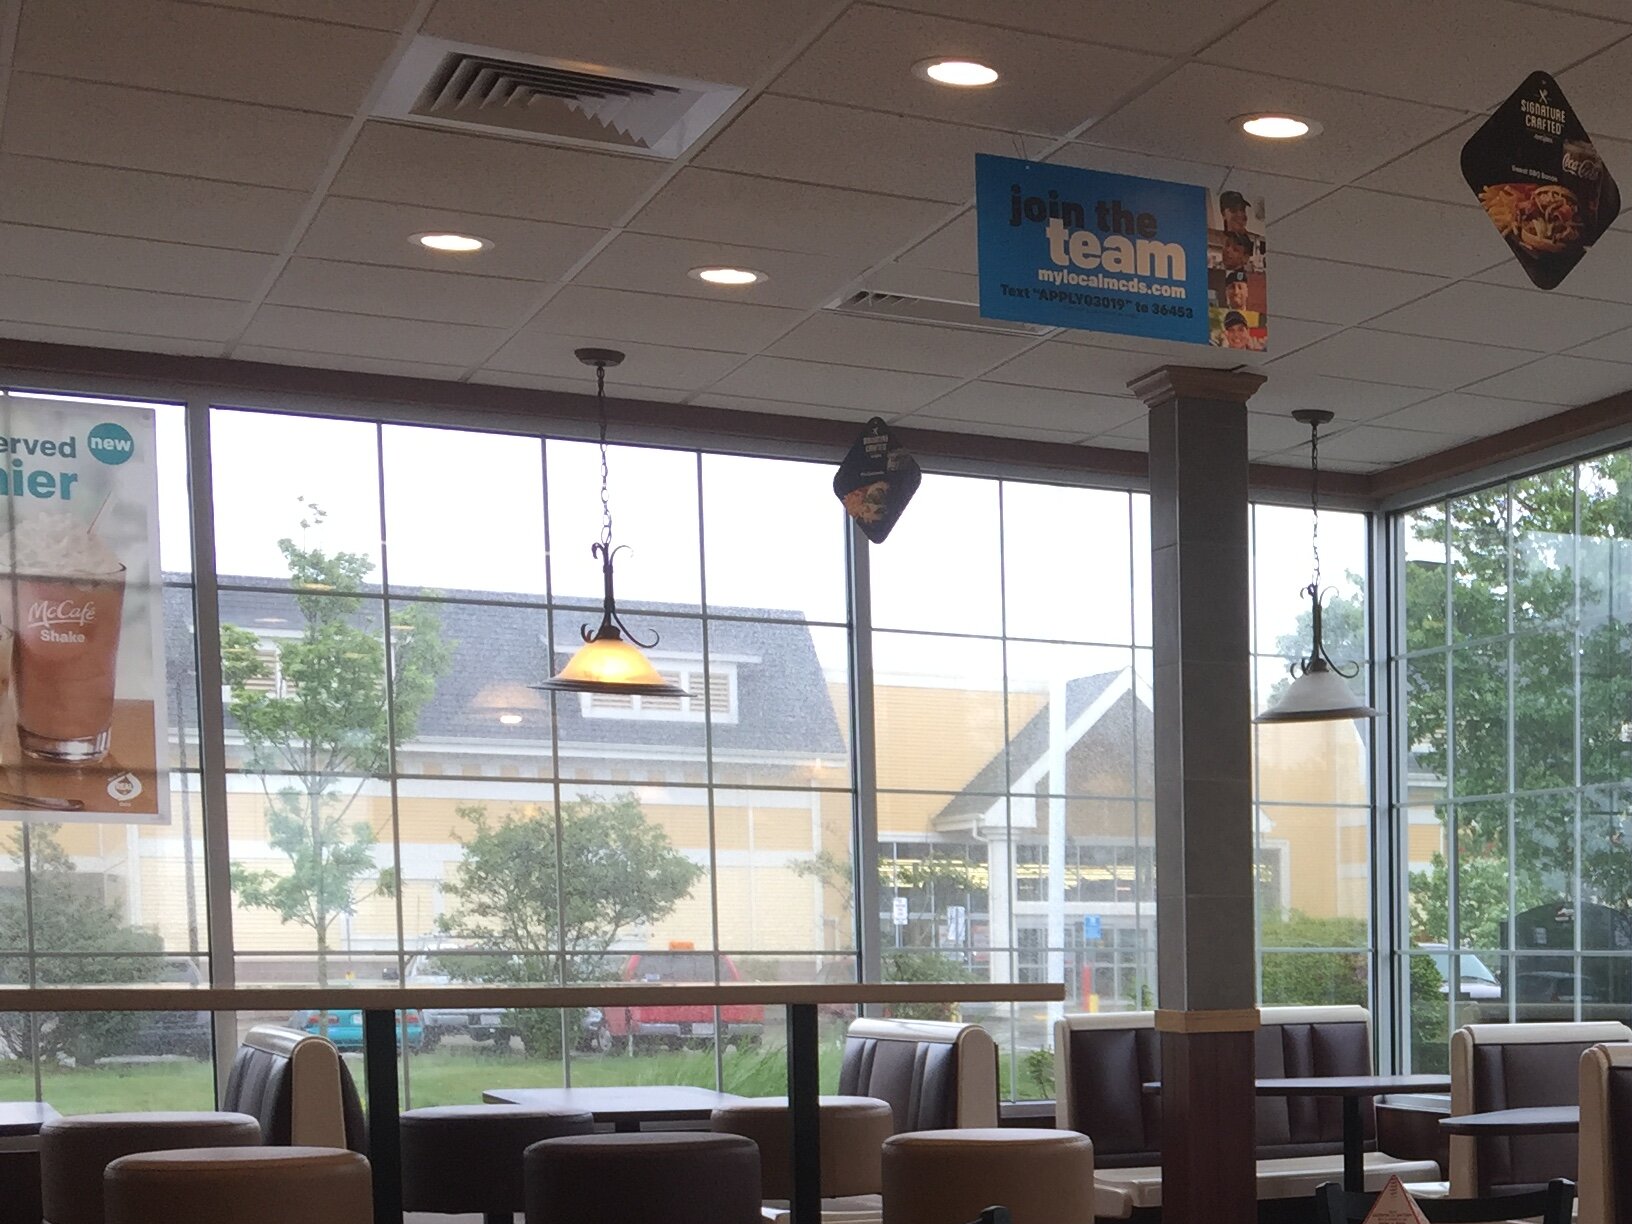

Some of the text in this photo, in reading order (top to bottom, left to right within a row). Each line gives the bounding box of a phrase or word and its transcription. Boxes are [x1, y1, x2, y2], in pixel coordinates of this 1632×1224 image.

[1520, 99, 1566, 123] SIGNATURE
[1525, 114, 1562, 135] CRAFTED
[1009, 184, 1157, 238] join the
[1046, 217, 1187, 281] team
[1038, 268, 1186, 299] mylocalmcds.com
[1001, 284, 1030, 299] Text
[1135, 300, 1148, 313] to
[90, 436, 131, 452] new
[28, 600, 96, 628] McCafé
[40, 629, 85, 643] Shake
